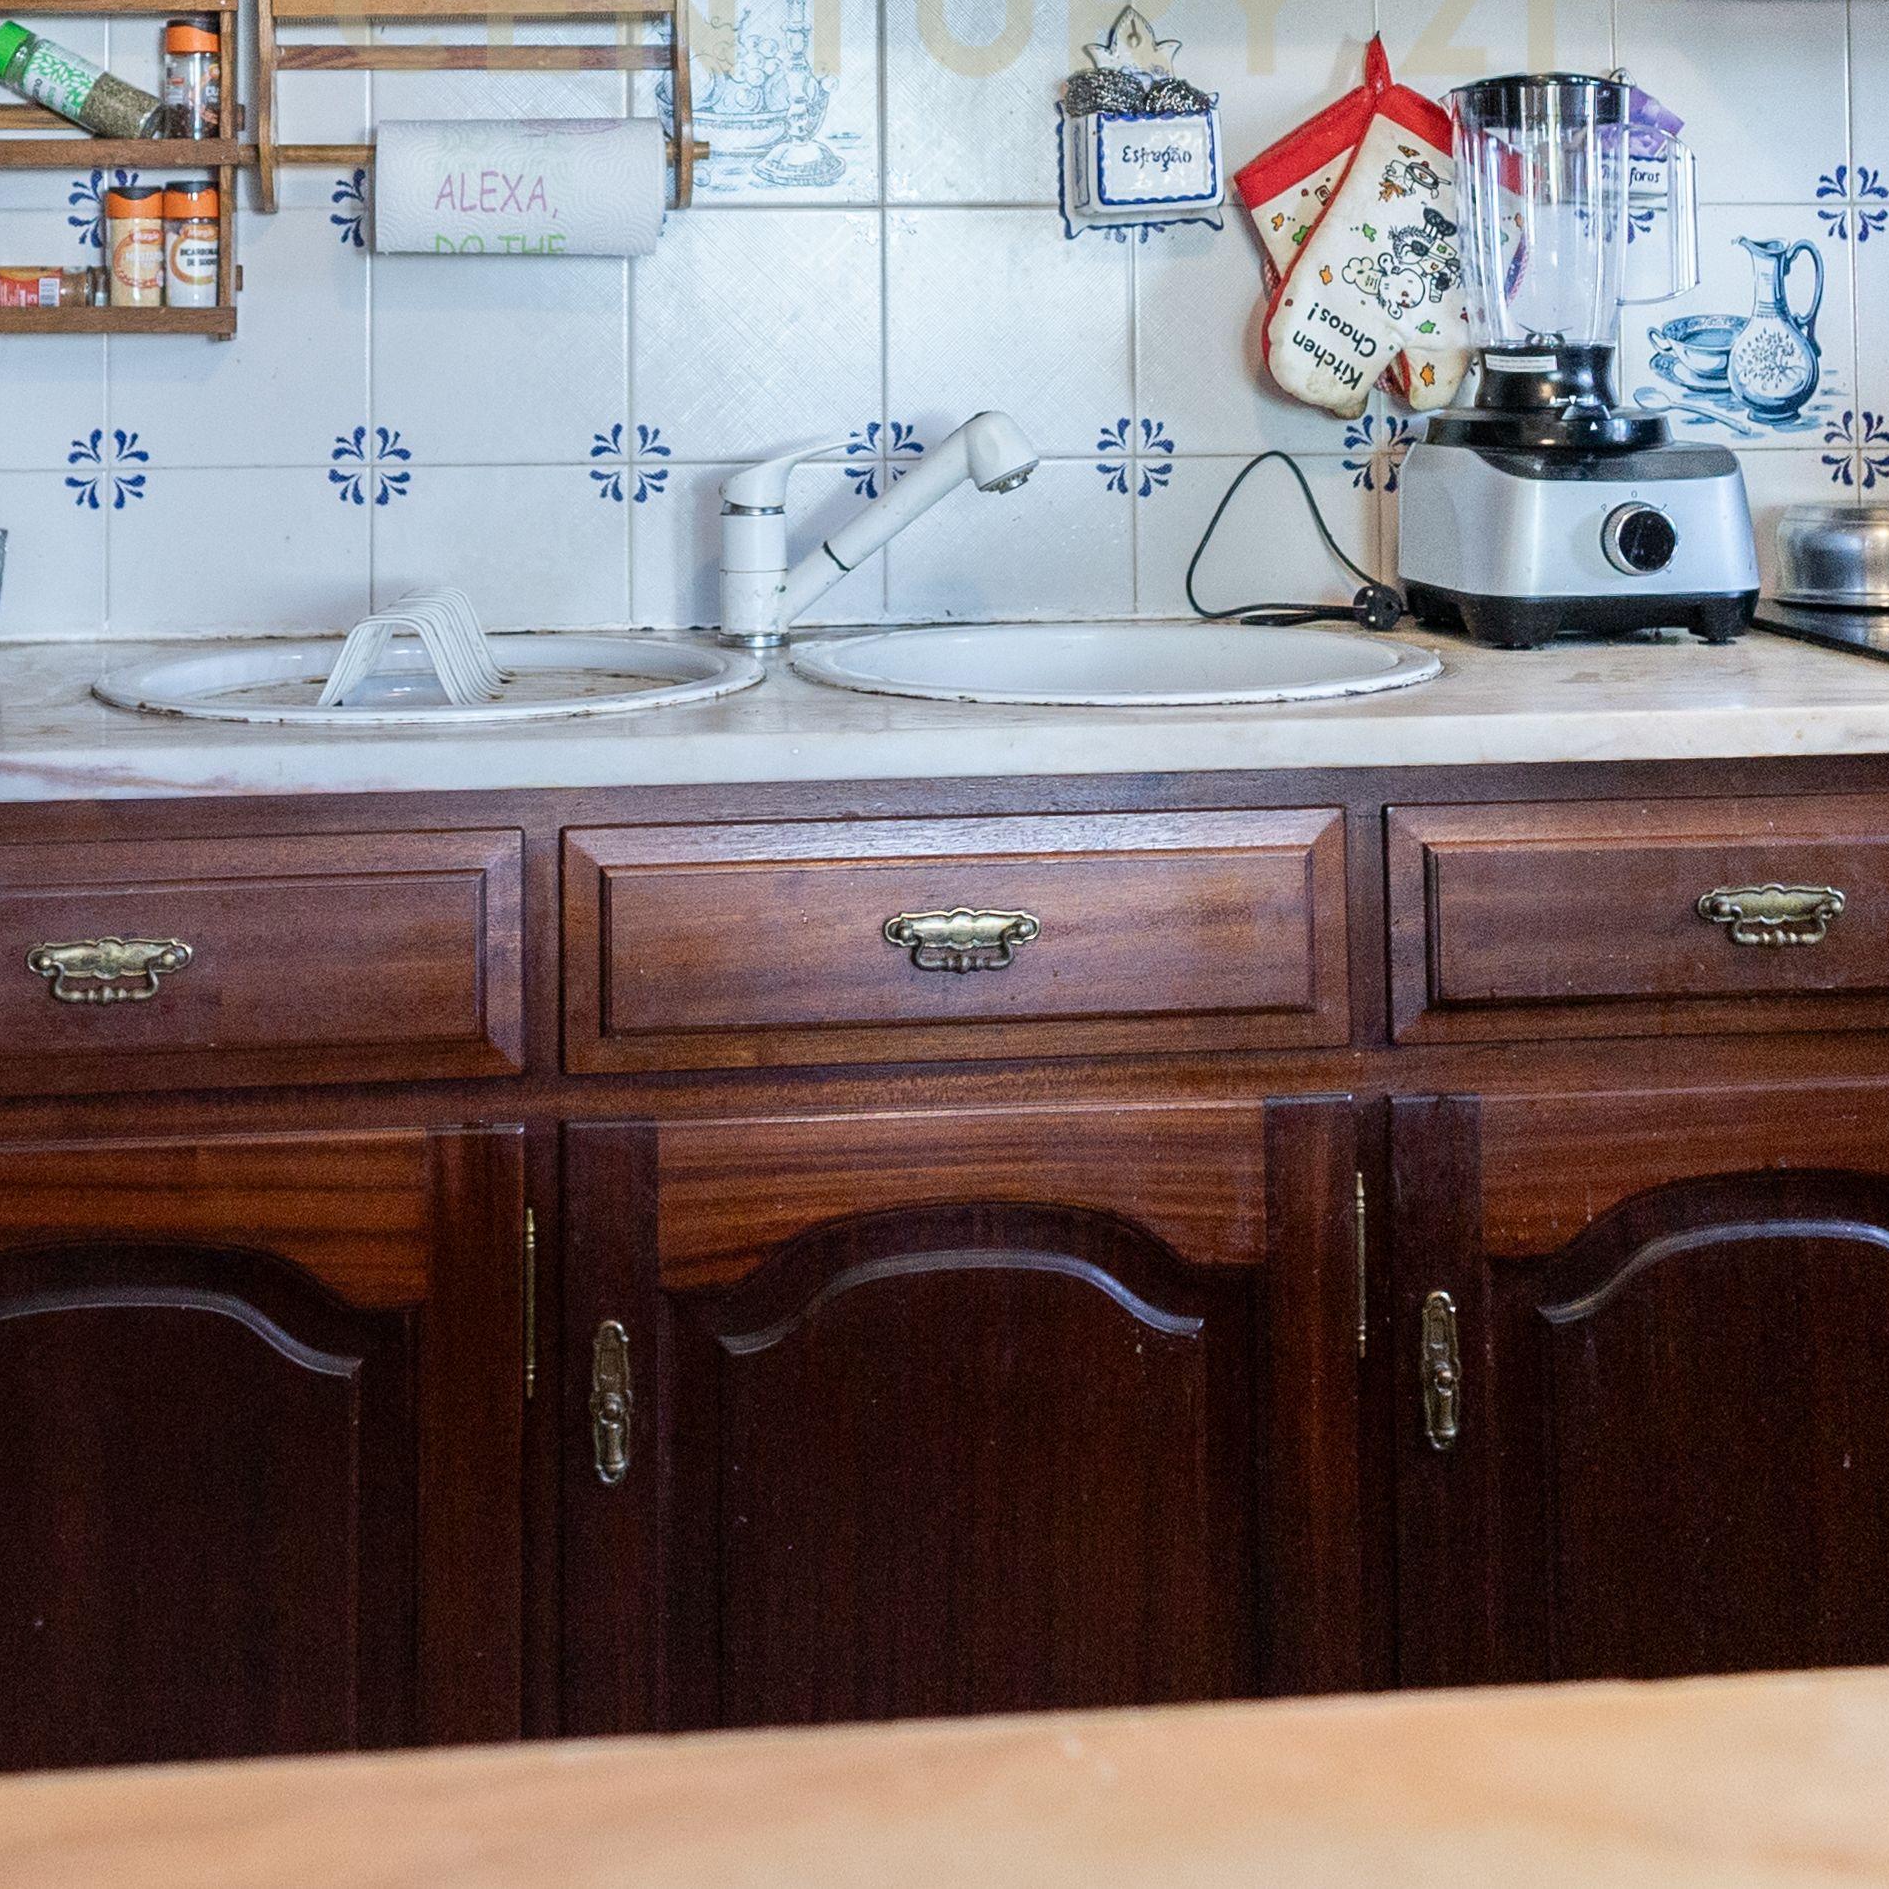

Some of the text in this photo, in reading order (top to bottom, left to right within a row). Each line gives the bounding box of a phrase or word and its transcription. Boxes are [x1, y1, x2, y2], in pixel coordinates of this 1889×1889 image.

[434, 170, 559, 219] ALEXA,
[1307, 302, 1377, 358] Chaos!
[1292, 329, 1364, 391] Kitchen
